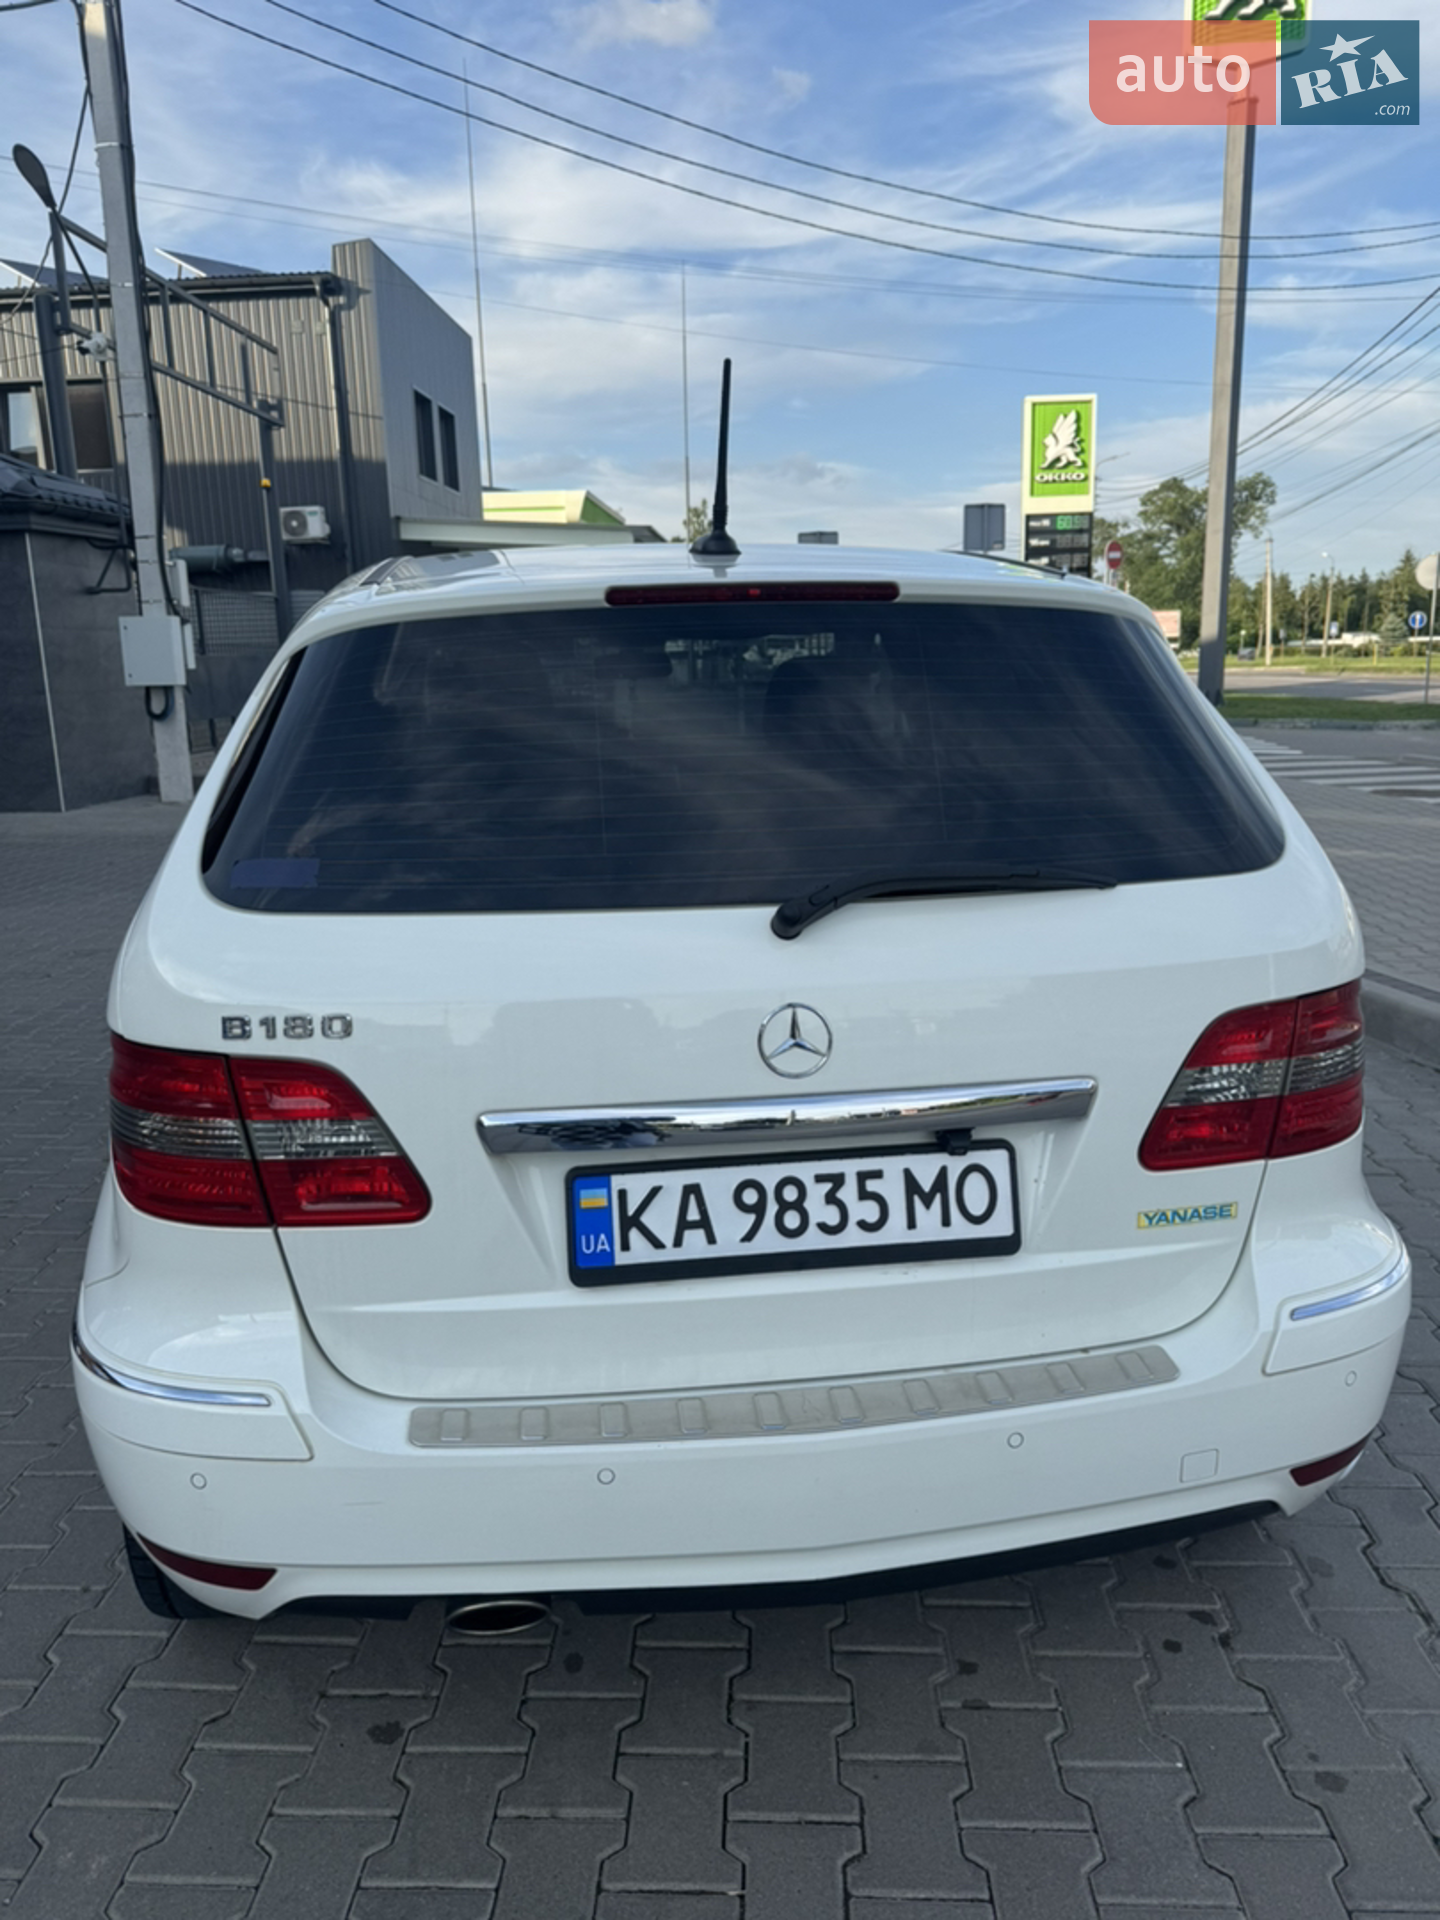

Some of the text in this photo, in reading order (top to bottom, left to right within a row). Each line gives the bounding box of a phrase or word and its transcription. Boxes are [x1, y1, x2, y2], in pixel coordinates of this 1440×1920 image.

[1034, 471, 1086, 482] OKKO
[617, 1163, 998, 1252] KA 9835 MO
[1143, 1203, 1232, 1226] YANASE
[581, 1232, 611, 1255] UA
